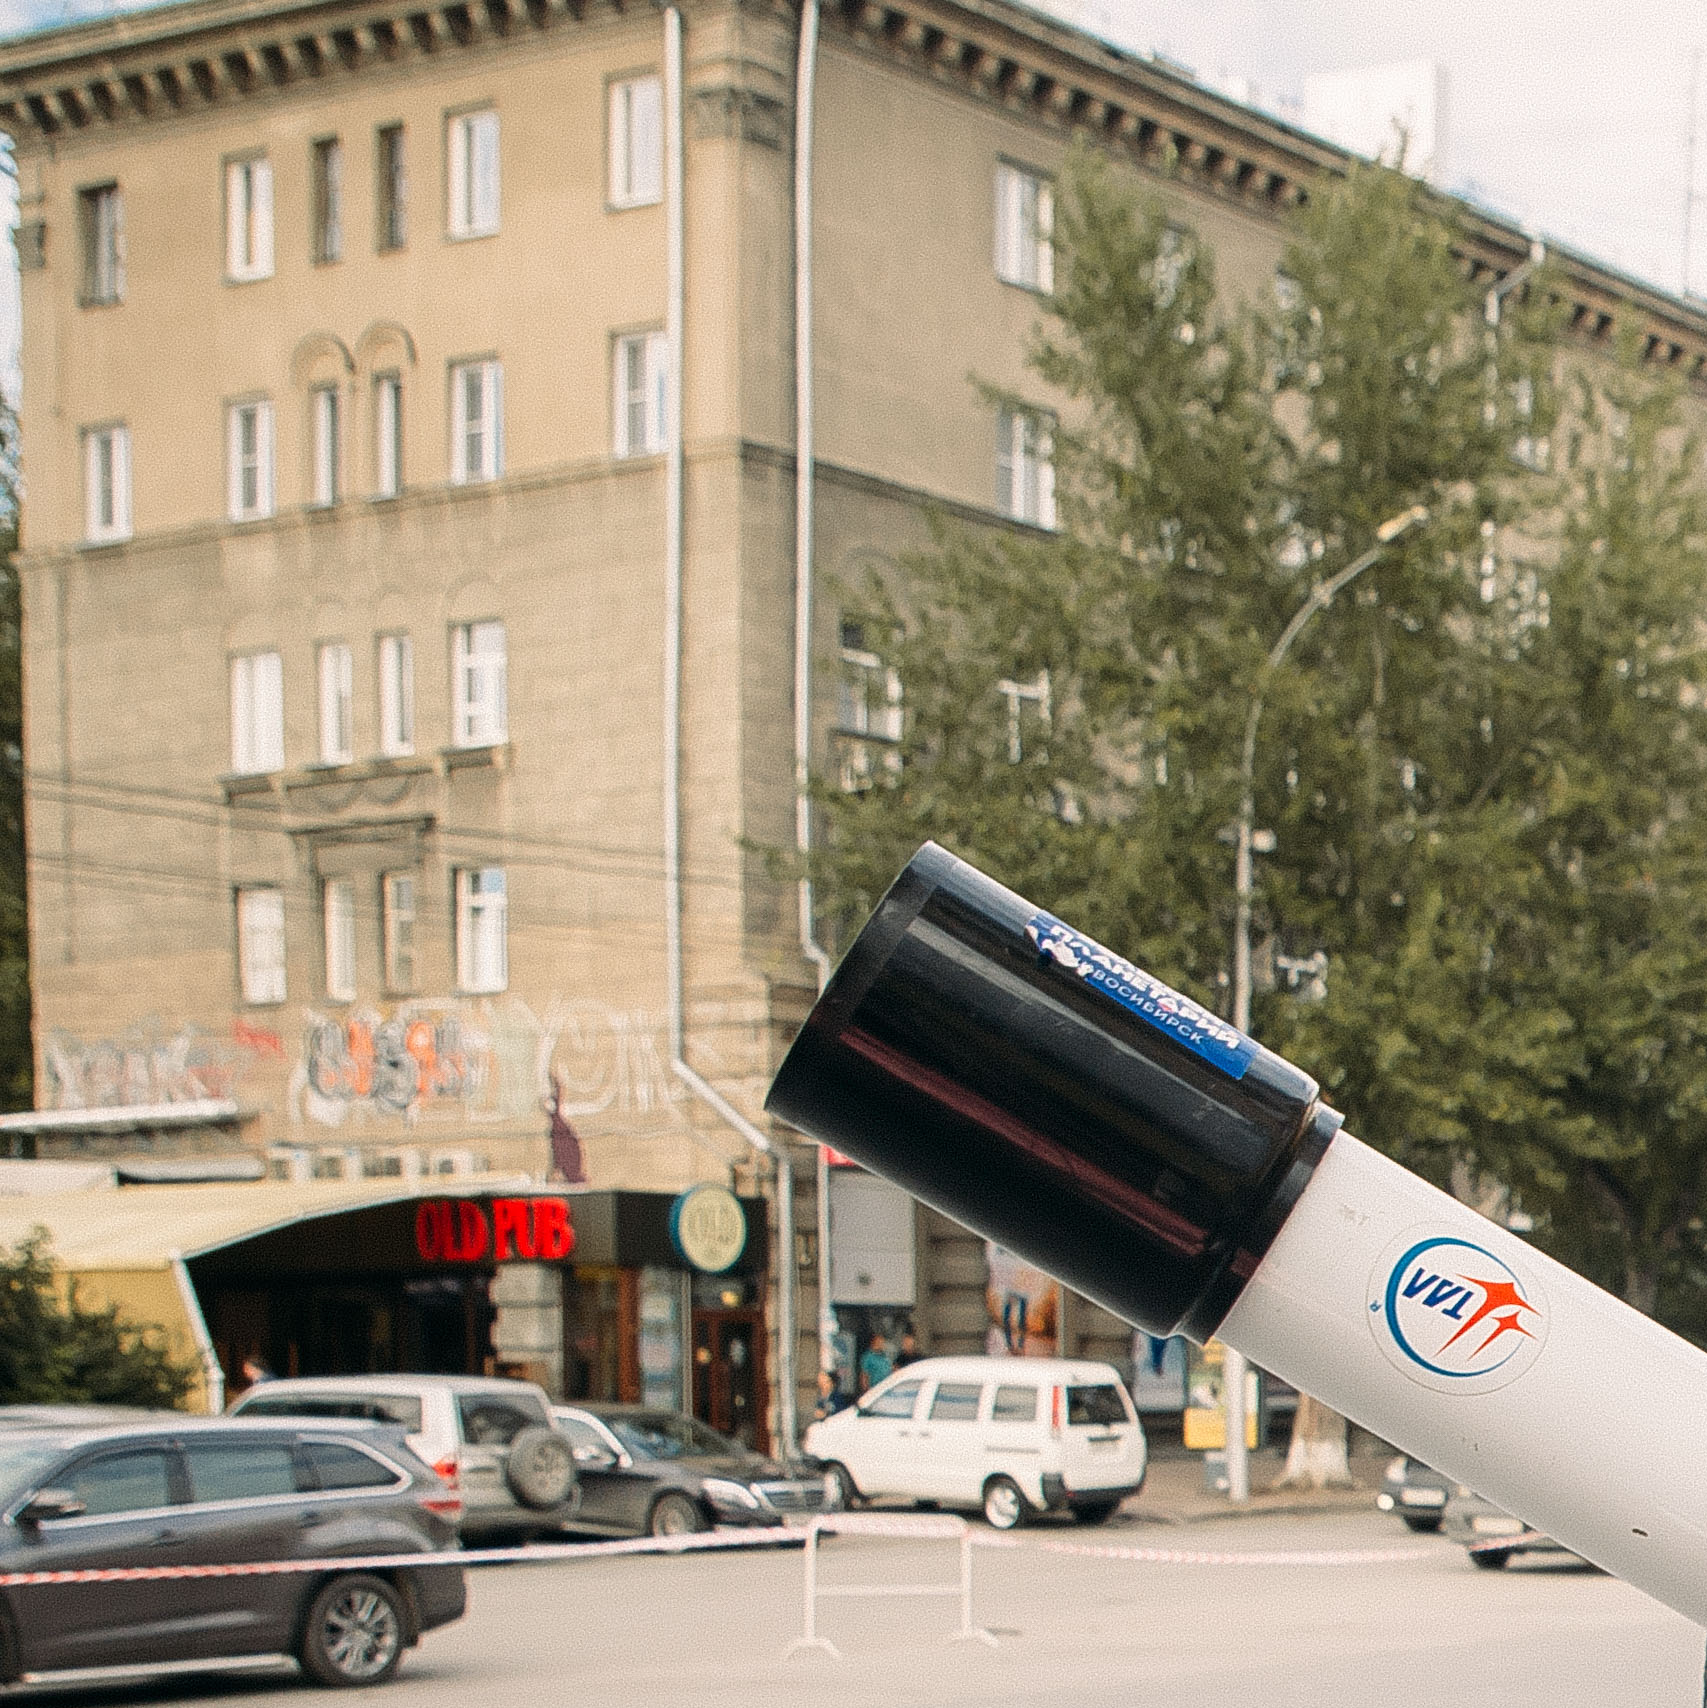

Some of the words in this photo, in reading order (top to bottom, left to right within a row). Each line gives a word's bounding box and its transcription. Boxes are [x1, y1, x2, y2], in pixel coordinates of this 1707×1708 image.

[1050, 924, 1241, 1050] ПЛАНЕТАРИЙ
[415, 1200, 488, 1261] OLD
[493, 1197, 575, 1260] PUB
